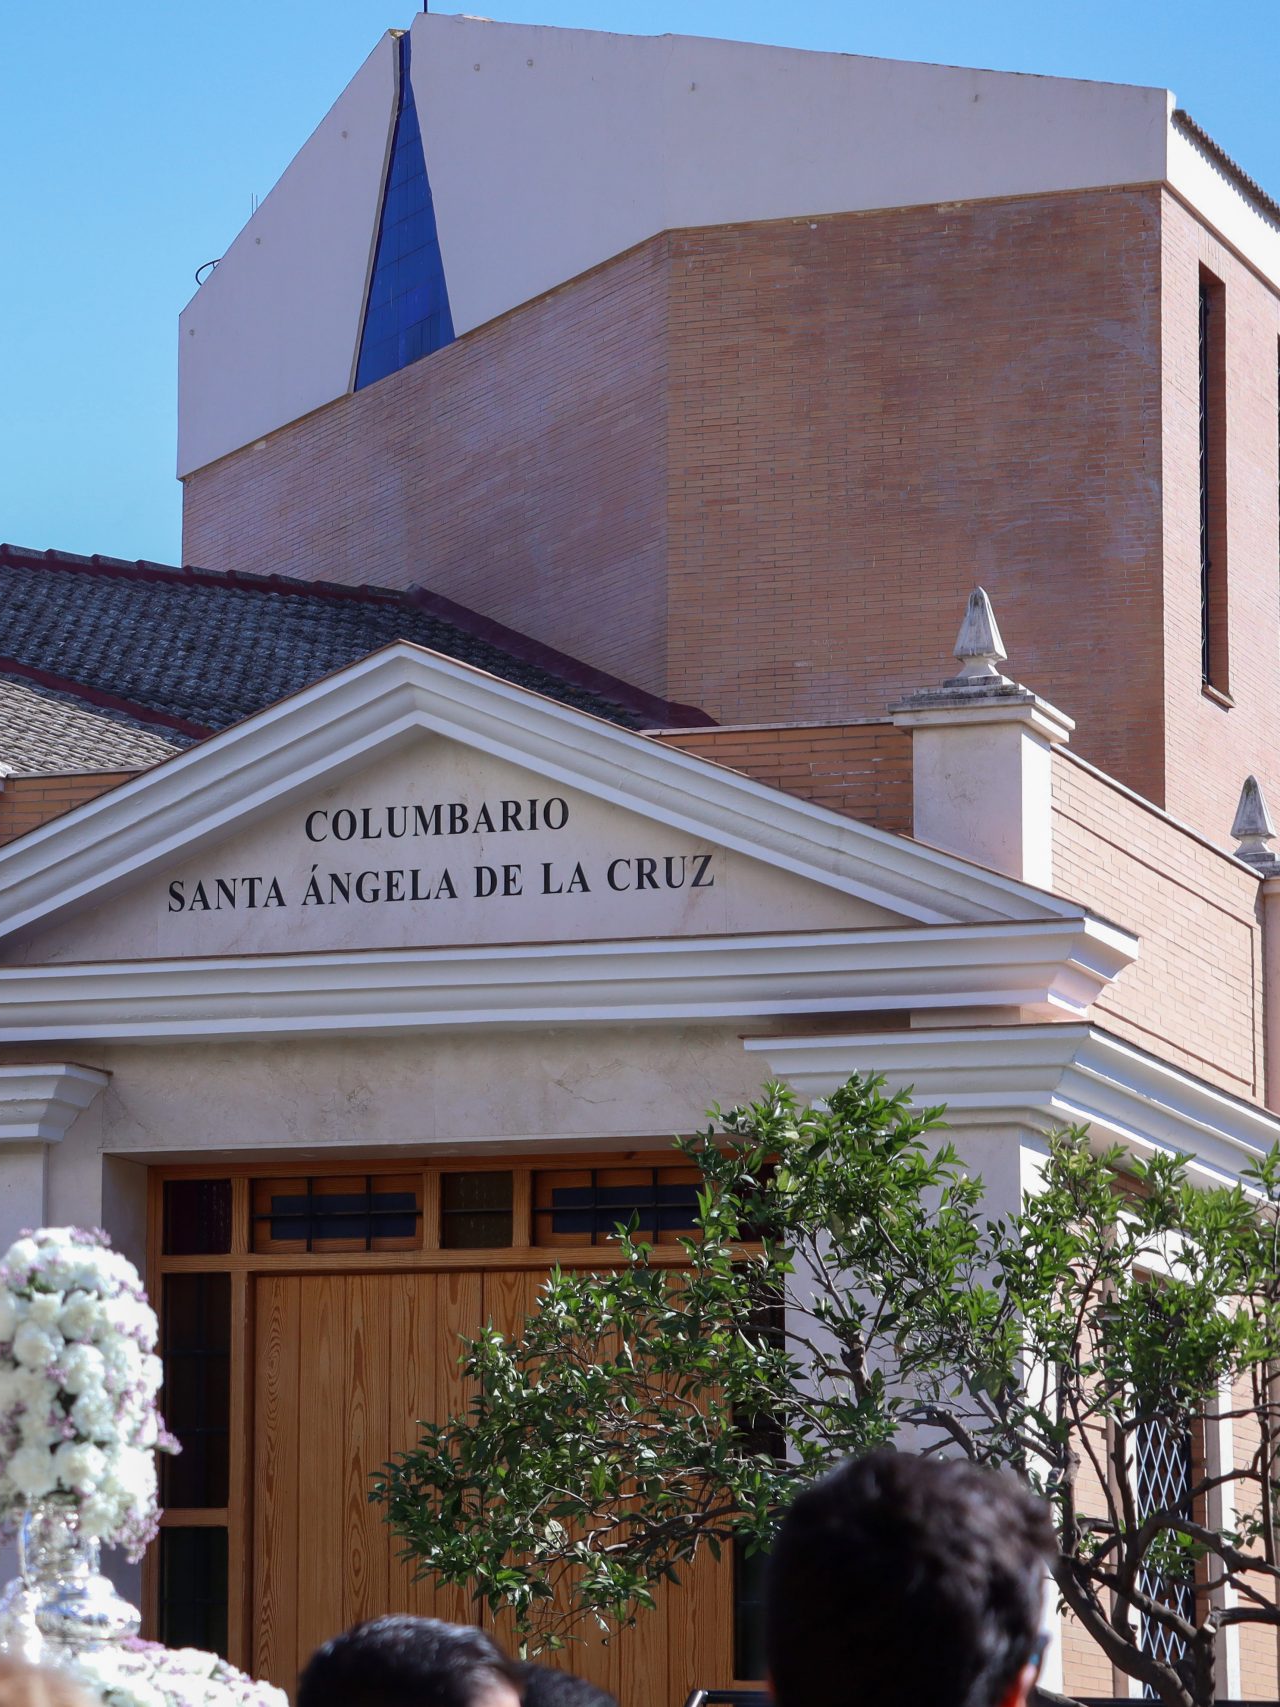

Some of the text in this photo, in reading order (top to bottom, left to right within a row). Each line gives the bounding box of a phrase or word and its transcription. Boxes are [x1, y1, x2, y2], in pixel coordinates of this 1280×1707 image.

[305, 796, 570, 843] COLUMBARIO
[168, 854, 715, 913] SANTA ÁNGELA DE LA CRUZ
